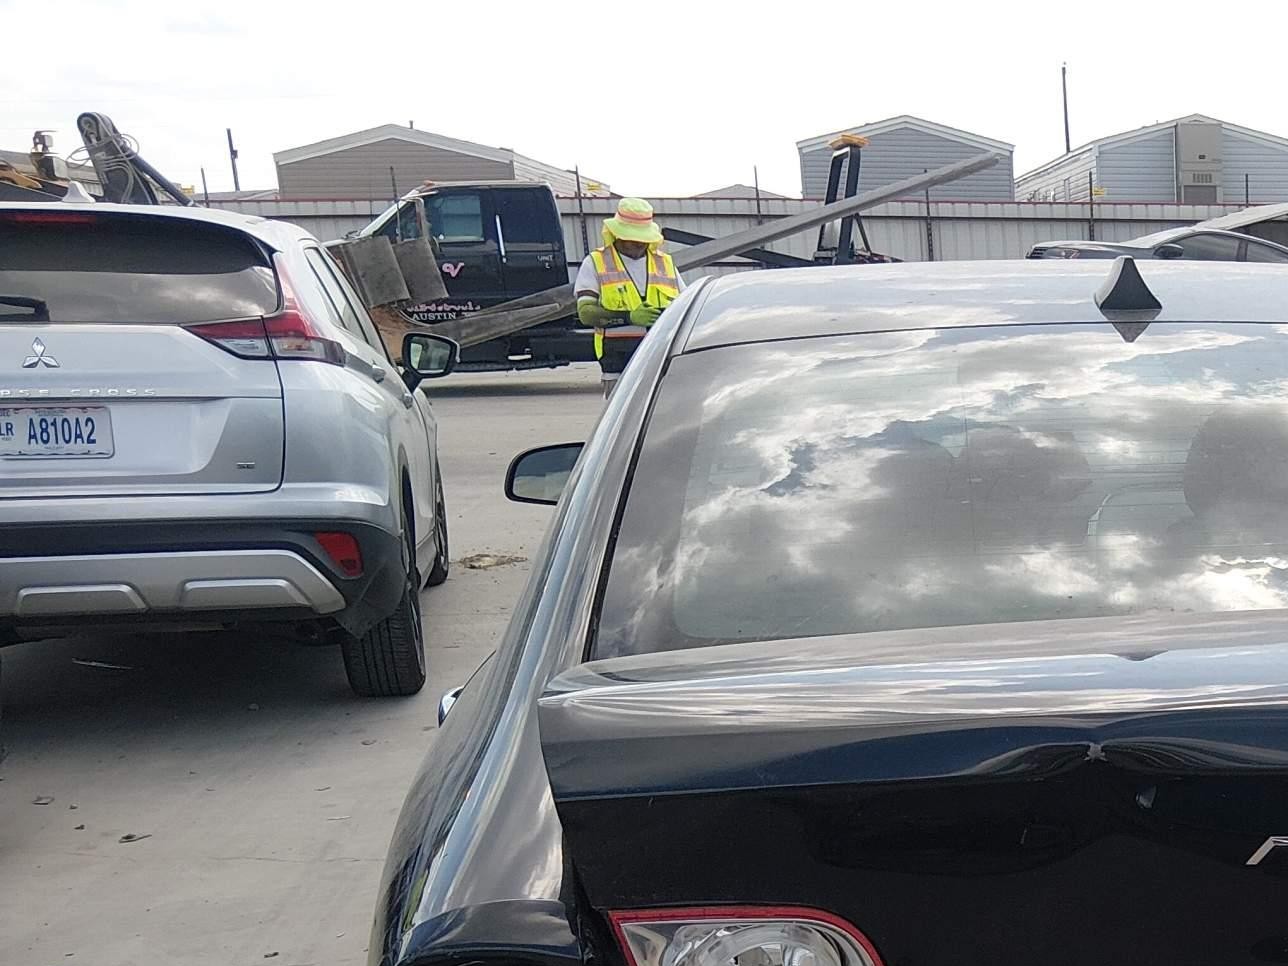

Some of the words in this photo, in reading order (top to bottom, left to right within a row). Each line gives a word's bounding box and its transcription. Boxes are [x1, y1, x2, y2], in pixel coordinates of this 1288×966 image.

[412, 312, 457, 321] AUSTIN
[71, 388, 156, 397] CROSS
[28, 416, 97, 445] A810A2
